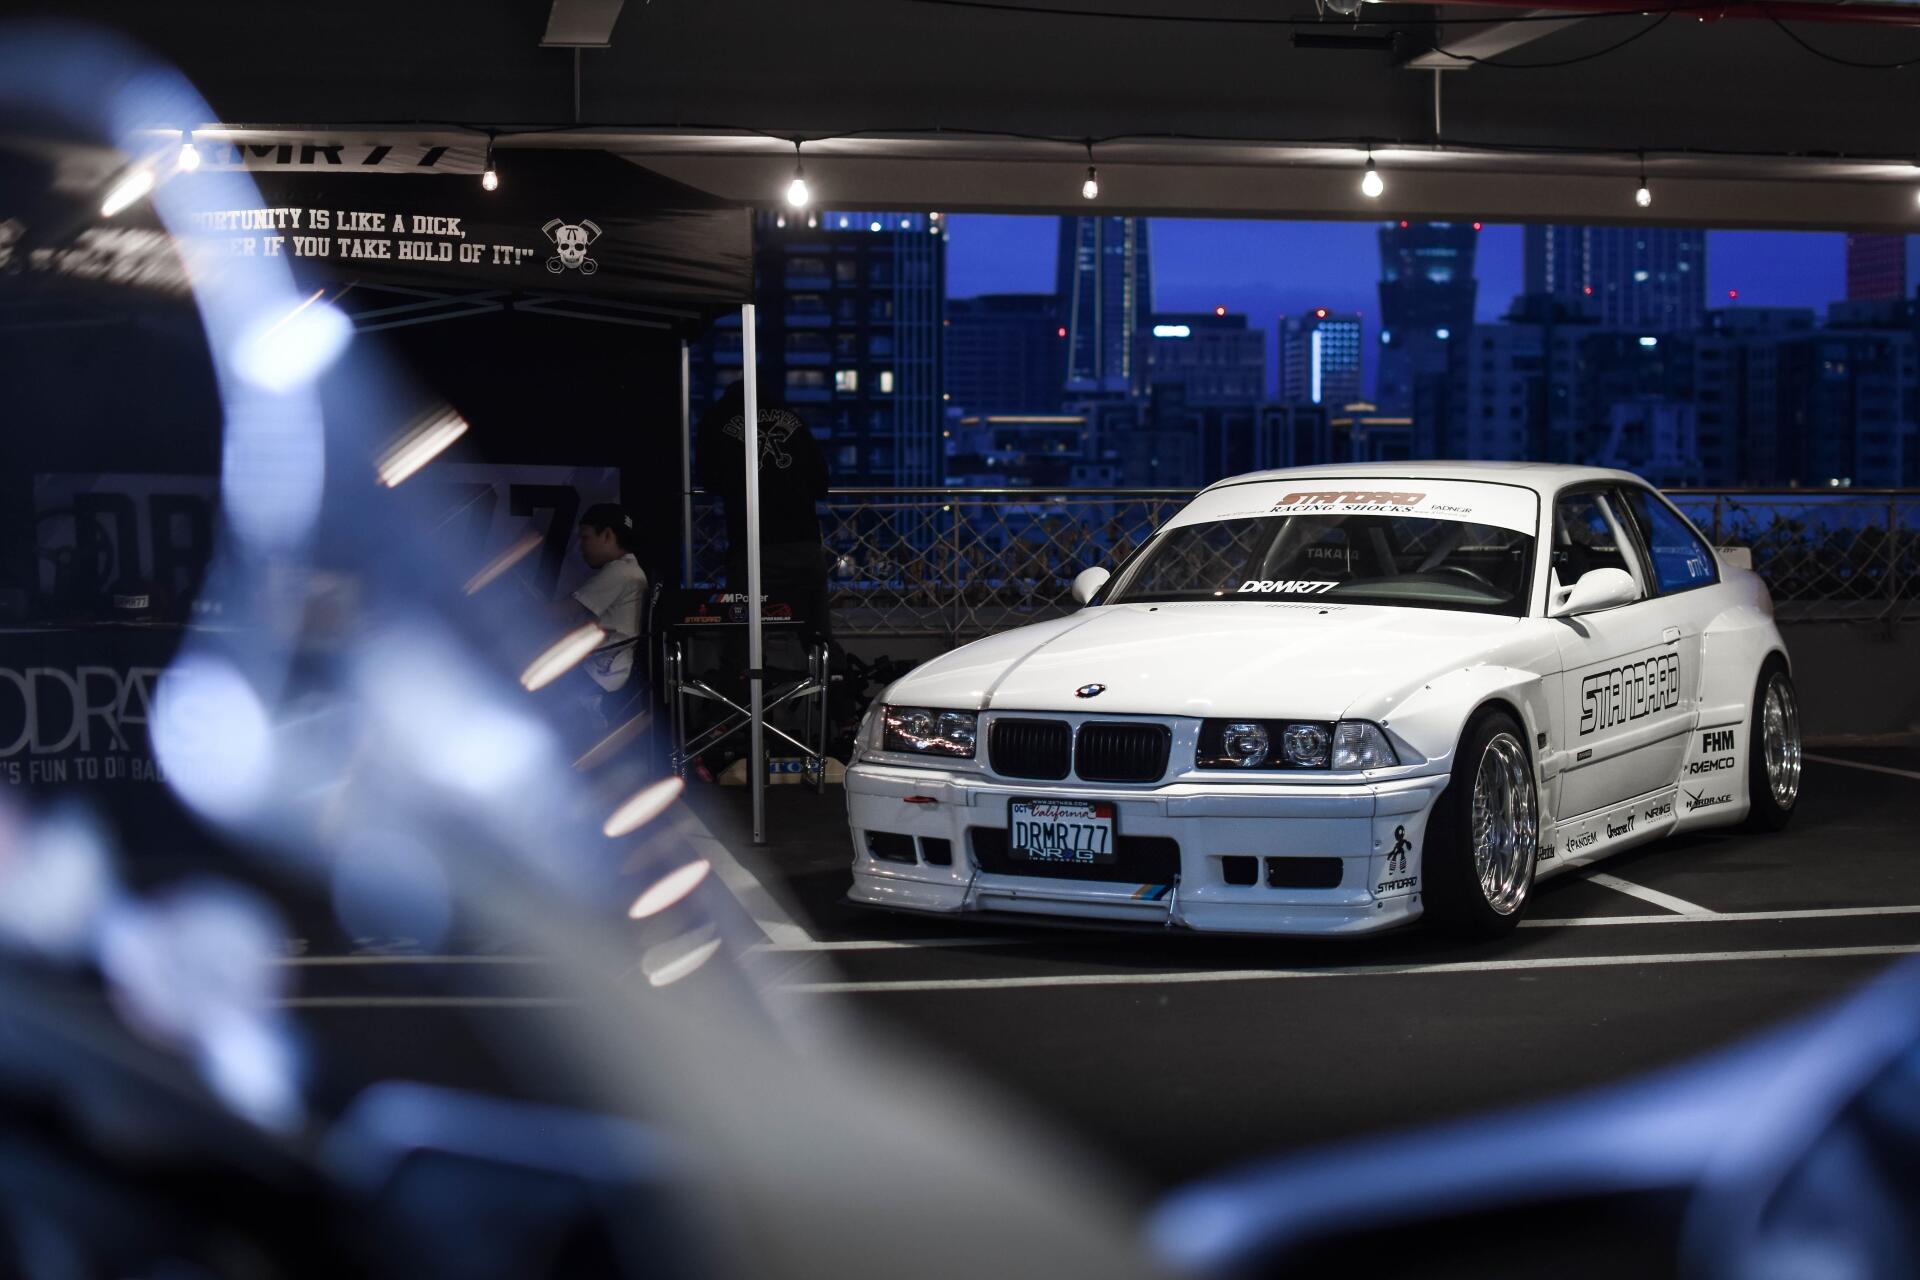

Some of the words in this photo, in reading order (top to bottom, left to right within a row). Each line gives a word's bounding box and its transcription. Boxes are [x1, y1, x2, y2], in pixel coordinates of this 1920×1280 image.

[308, 209, 330, 230] IS
[336, 211, 386, 232] LIKE
[392, 214, 405, 233] A
[412, 215, 466, 238] DICK,
[263, 236, 284, 256] IF
[292, 236, 331, 257] YOU
[337, 238, 391, 259] TAKE
[398, 240, 453, 262] HOLD
[459, 243, 485, 264] OF
[721, 408, 803, 440] DRAMER
[1269, 504, 1335, 513] RACING
[1341, 504, 1415, 513] SHOCKS
[1275, 491, 1427, 506] STANDARD
[735, 593, 769, 604] Poer
[1237, 580, 1341, 594] DRMR77
[1580, 652, 1680, 736] STANDARD
[1703, 730, 1735, 754] FHM
[30, 758, 67, 784] FUN
[74, 756, 98, 780] TO
[1031, 804, 1091, 821] California
[1016, 821, 1108, 853] DRMR777
[1377, 876, 1418, 894] STANDARD
